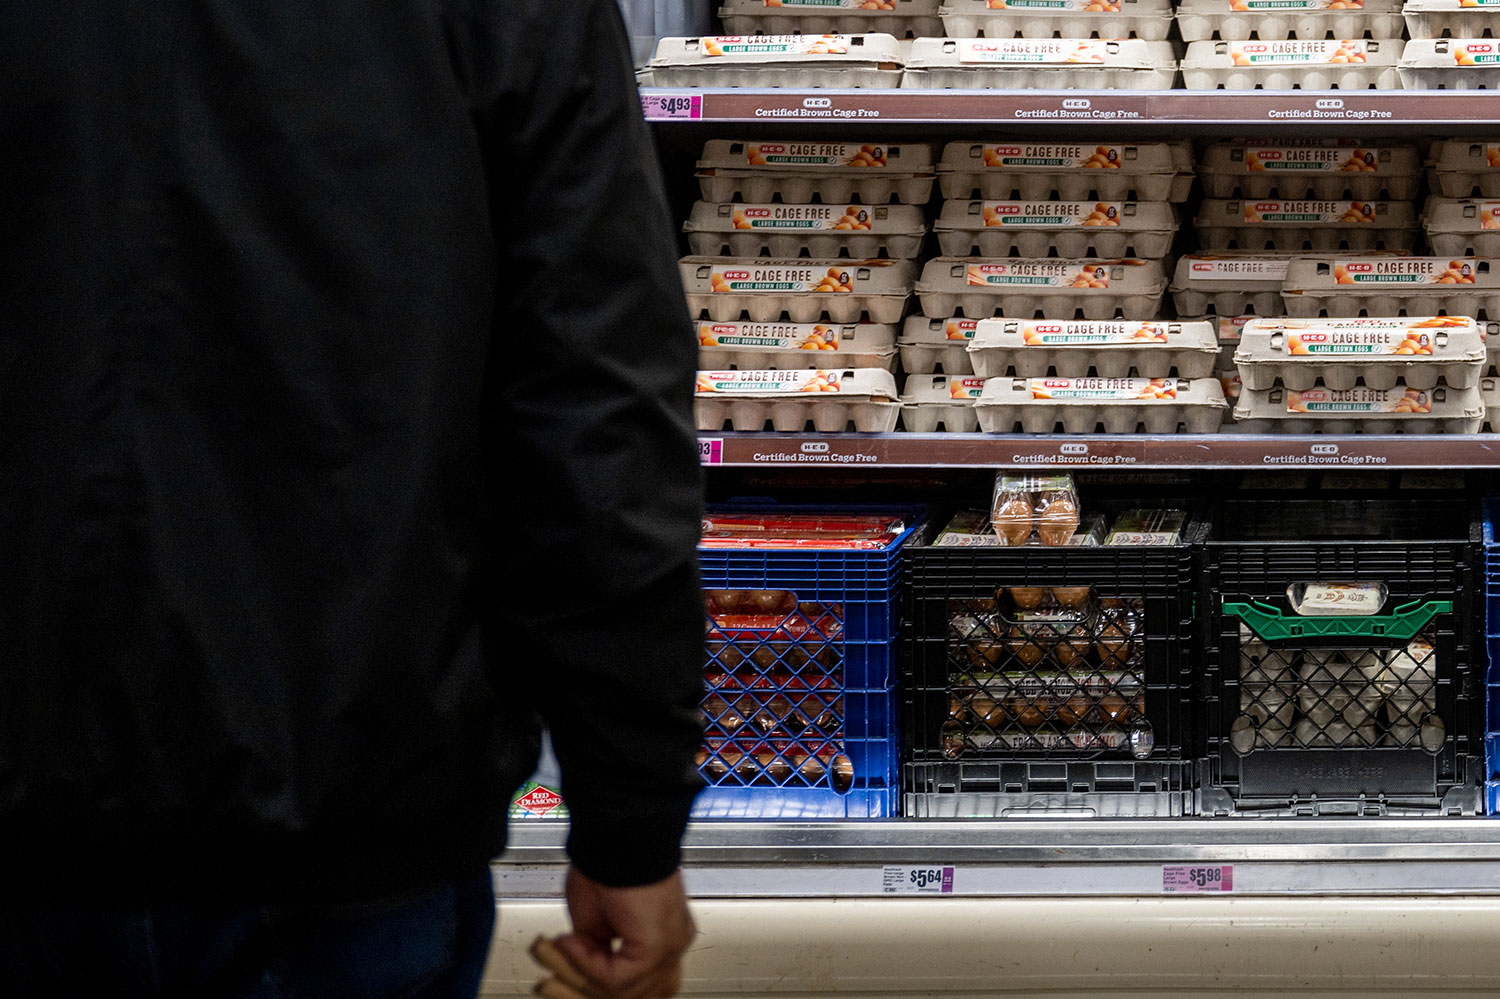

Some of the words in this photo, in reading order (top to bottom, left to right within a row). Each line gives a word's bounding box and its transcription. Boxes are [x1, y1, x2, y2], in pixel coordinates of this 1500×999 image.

[755, 109, 799, 117] Certified
[800, 109, 831, 117] Brown
[833, 109, 856, 118] Cage
[858, 109, 879, 117] Free
[1015, 110, 1058, 118] Certified
[1060, 110, 1090, 118] Brown
[1092, 110, 1116, 119] Cage
[1117, 110, 1138, 118] Free
[755, 270, 781, 281] CAGE
[785, 270, 811, 281] FREE
[1333, 333, 1359, 343] CAGE
[1364, 333, 1390, 343] FREE
[753, 453, 796, 461] Certified
[798, 453, 829, 461] Brown
[831, 453, 854, 462] Cage
[856, 453, 877, 461] Free
[1013, 455, 1056, 463] Certified
[1058, 455, 1088, 463] Brown
[1090, 455, 1113, 464] Cage
[1115, 455, 1136, 463] Free
[1263, 455, 1306, 463] Certified
[1308, 455, 1339, 463] Brown
[1341, 455, 1364, 464] Cage
[1366, 455, 1387, 463] Free
[521, 798, 561, 806] DIAMOND
